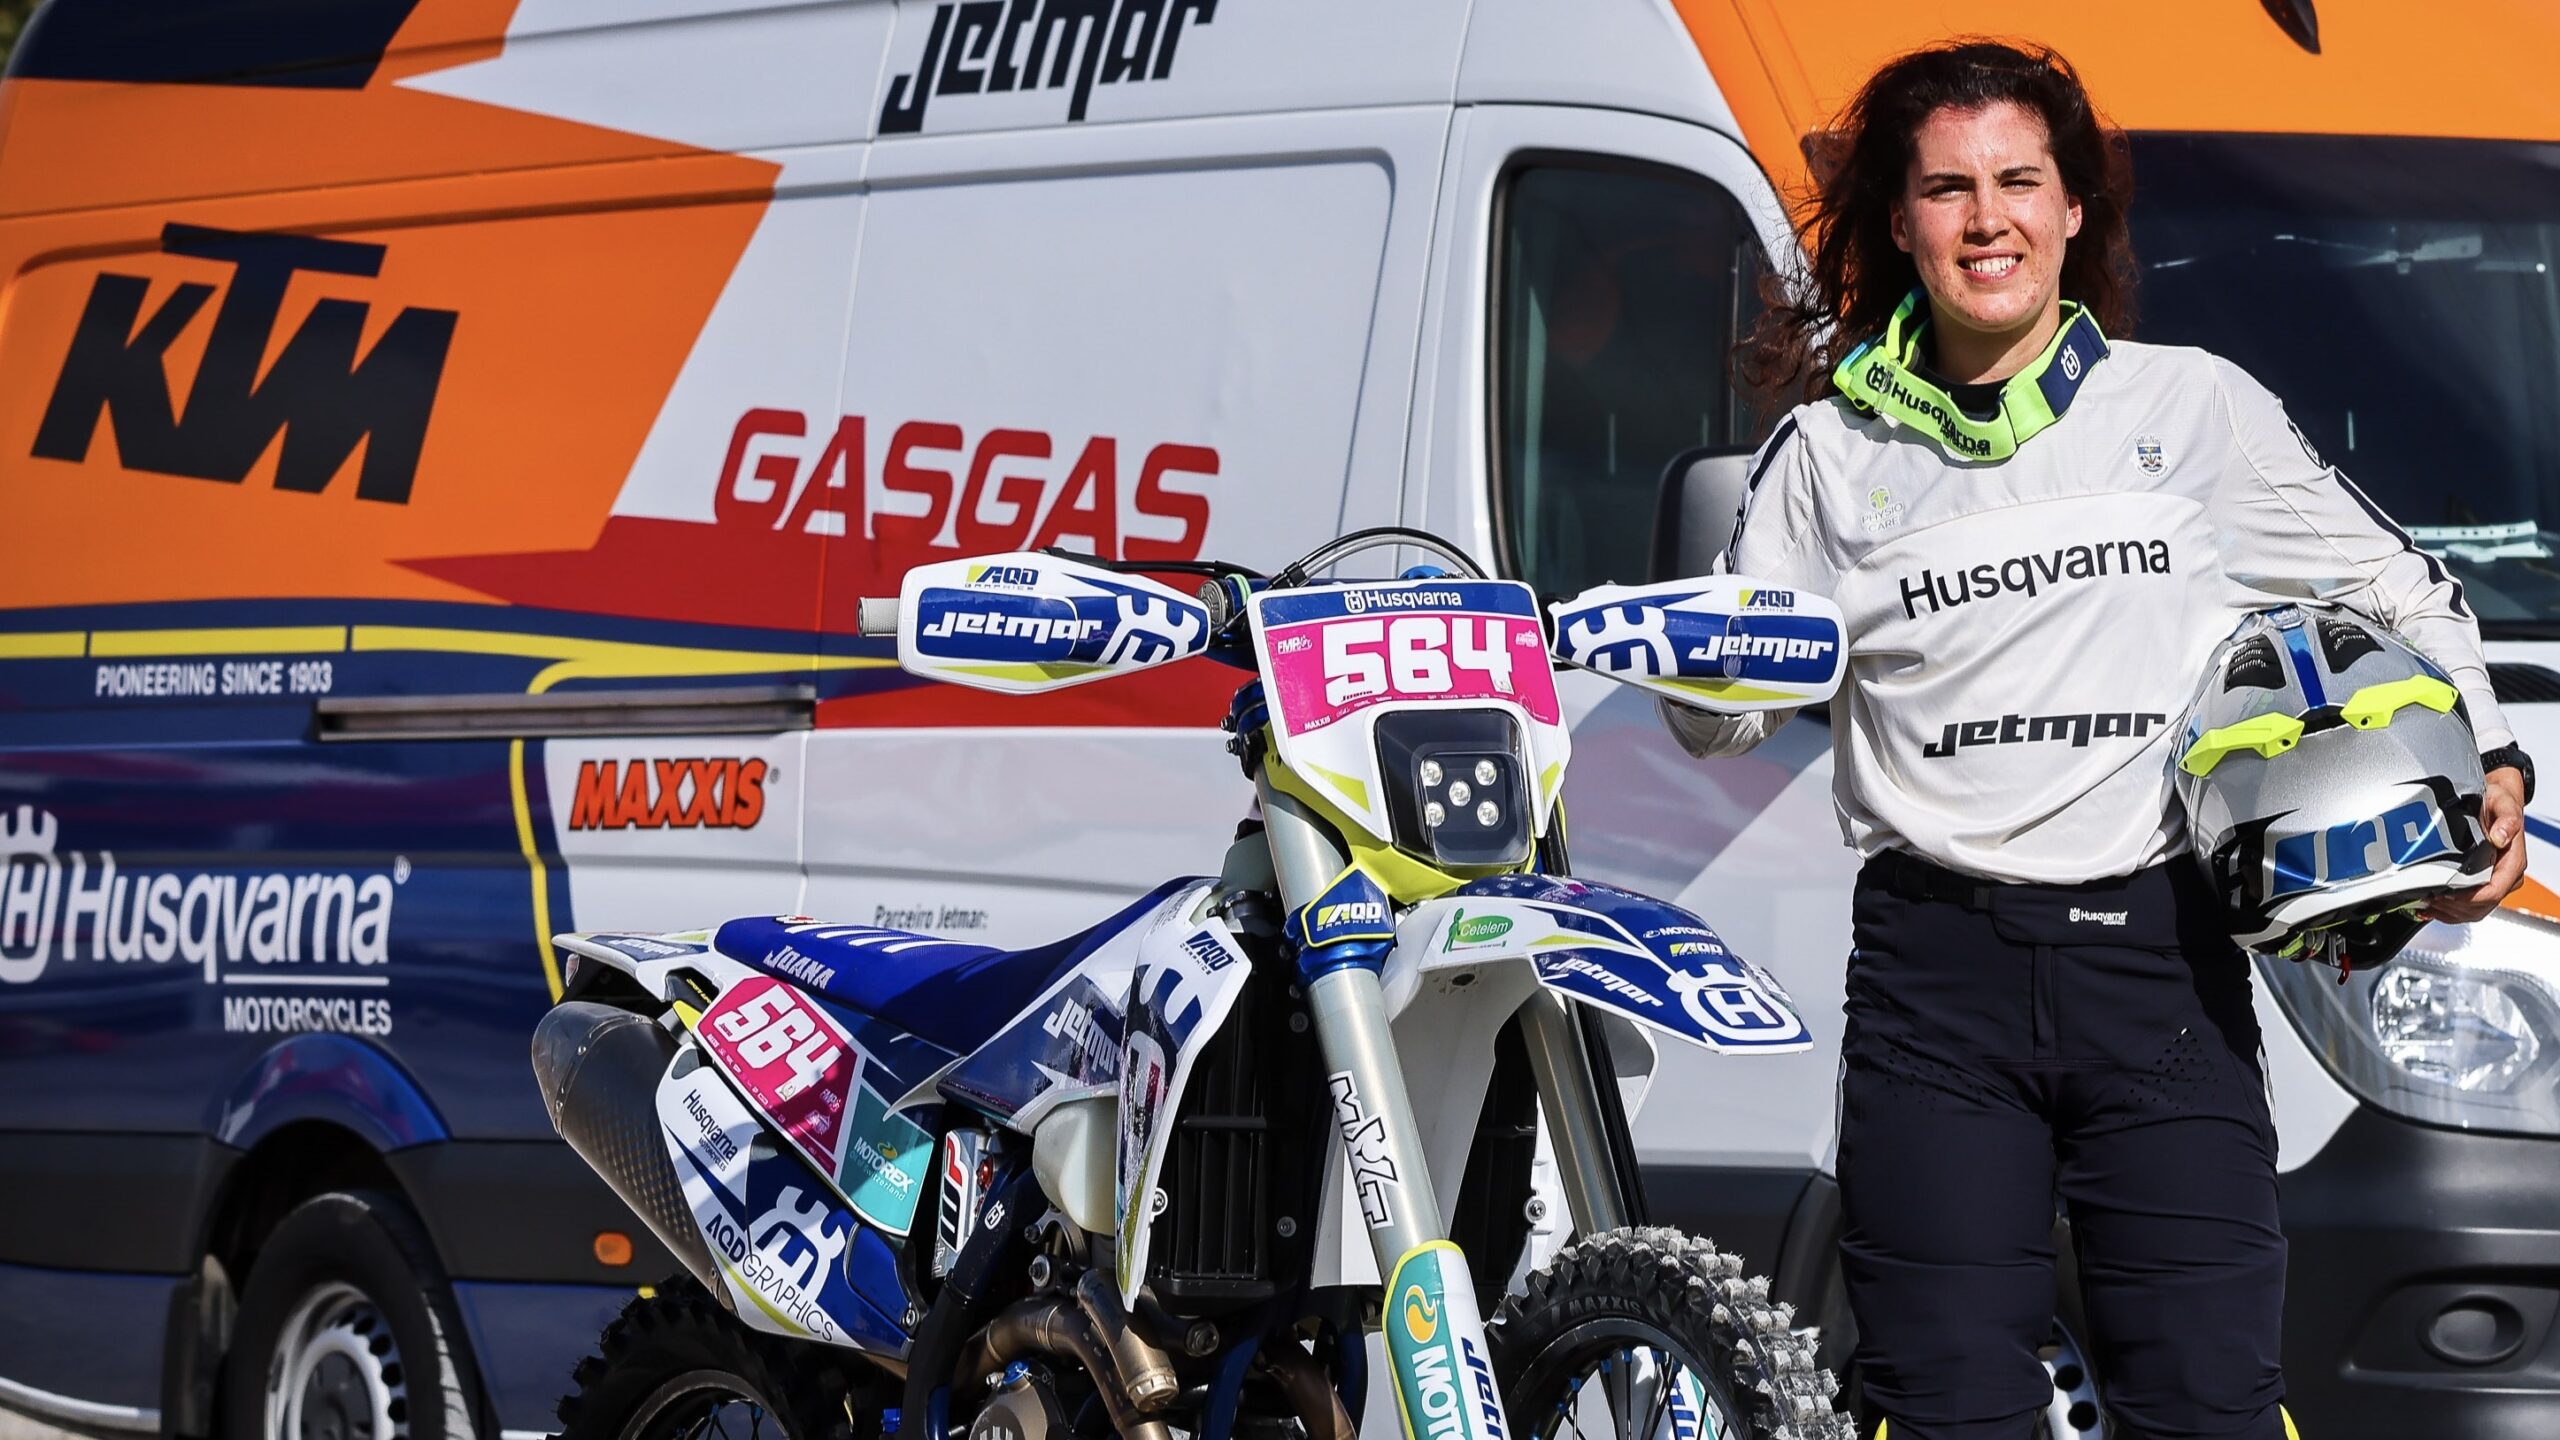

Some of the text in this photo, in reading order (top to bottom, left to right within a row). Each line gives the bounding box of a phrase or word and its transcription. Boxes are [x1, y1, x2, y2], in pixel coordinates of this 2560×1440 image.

[30, 222, 460, 505] KTM
[714, 407, 1221, 564] GASGAS
[1365, 591, 1462, 608] Husqvarna
[1900, 539, 2170, 620] Husqvarna
[922, 611, 1102, 645] Jetmar
[1688, 633, 1834, 663] Jetmar
[96, 660, 333, 697] PIONEERING SINCE 1903
[1322, 616, 1515, 708] 564
[1923, 713, 2166, 758] Jetmar
[569, 757, 768, 831] MAXXIS
[874, 903, 989, 930] Parceiro Jetmar:
[1317, 902, 1382, 926] AQD
[1460, 922, 1509, 937] Cetelem
[763, 944, 836, 990] JOANA
[1547, 957, 1664, 1007] Jetmar
[223, 997, 393, 1035] MOTORCYCLES
[1042, 996, 1122, 1076] Jetmar
[713, 983, 842, 1102] 564
[683, 1088, 738, 1162] Husqvarna
[854, 1136, 916, 1194] MOTOREX
[1569, 1295, 1643, 1317] MAXXIS
[1409, 1344, 1466, 1440] MOT
